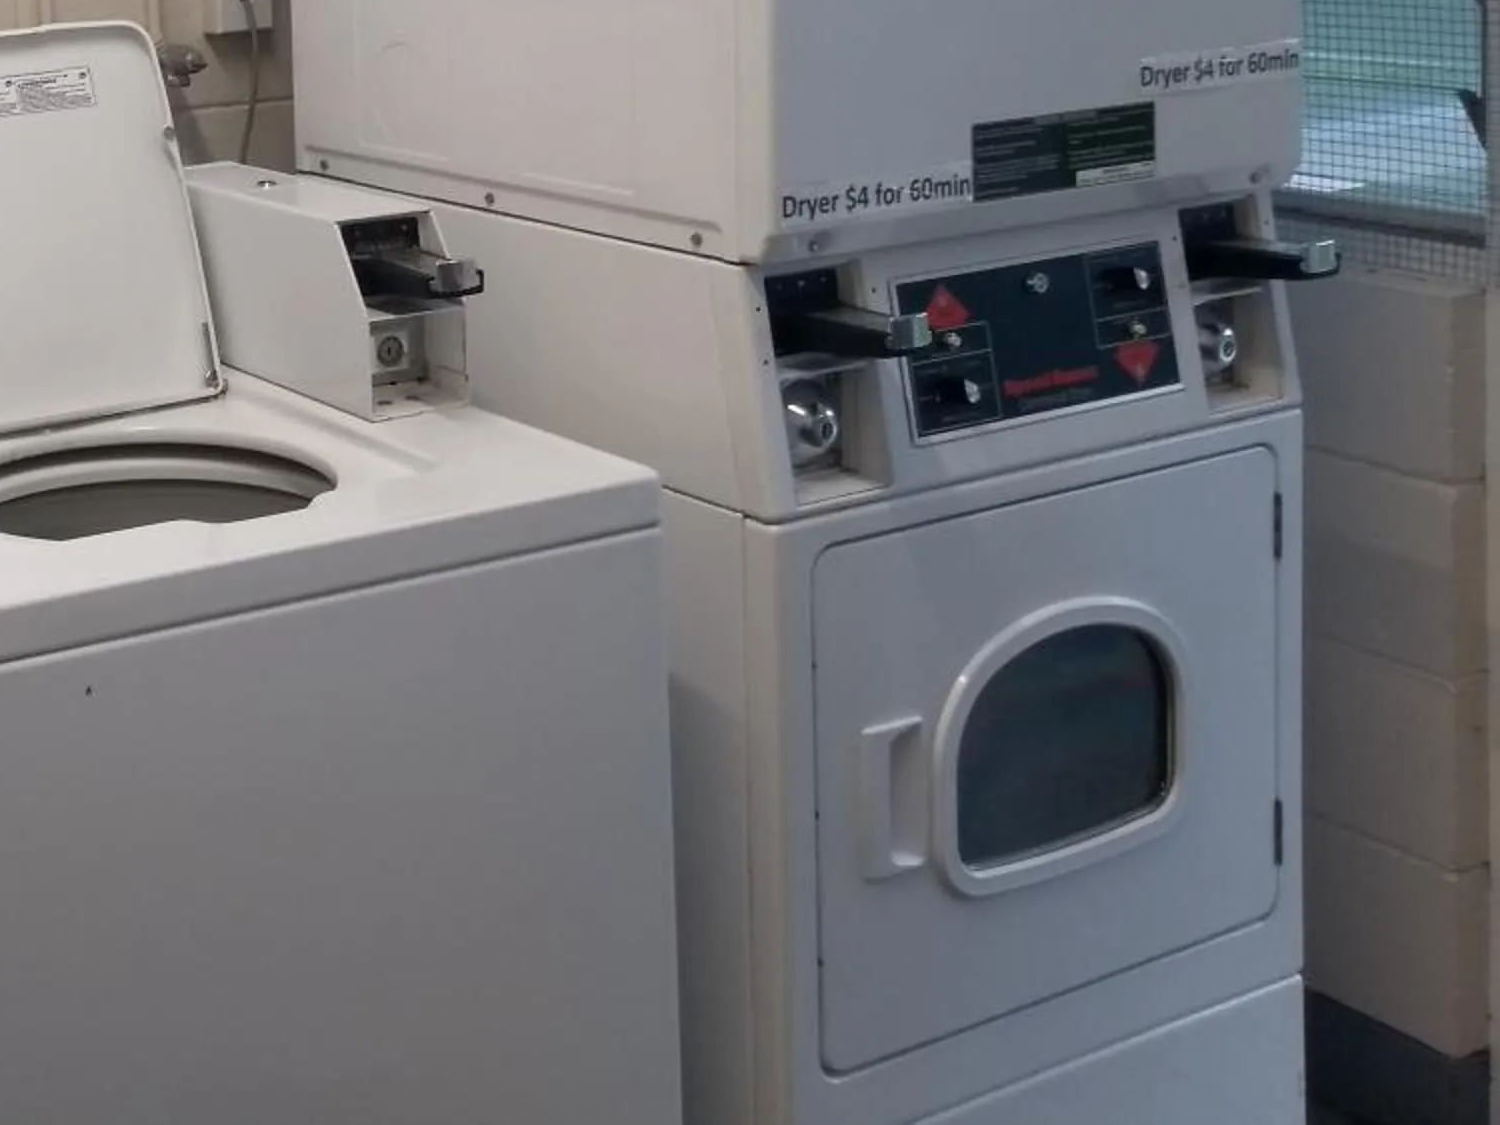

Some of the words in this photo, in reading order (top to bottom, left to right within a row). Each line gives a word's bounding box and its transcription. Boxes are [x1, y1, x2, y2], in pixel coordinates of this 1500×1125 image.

[1140, 63, 1190, 89] Dryer
[1193, 55, 1214, 82] $4
[1219, 55, 1244, 76] for
[1247, 48, 1299, 74] 60min
[782, 194, 839, 221] Dryer
[846, 182, 869, 211] $4
[875, 181, 904, 207] for
[909, 174, 971, 202] 60min
